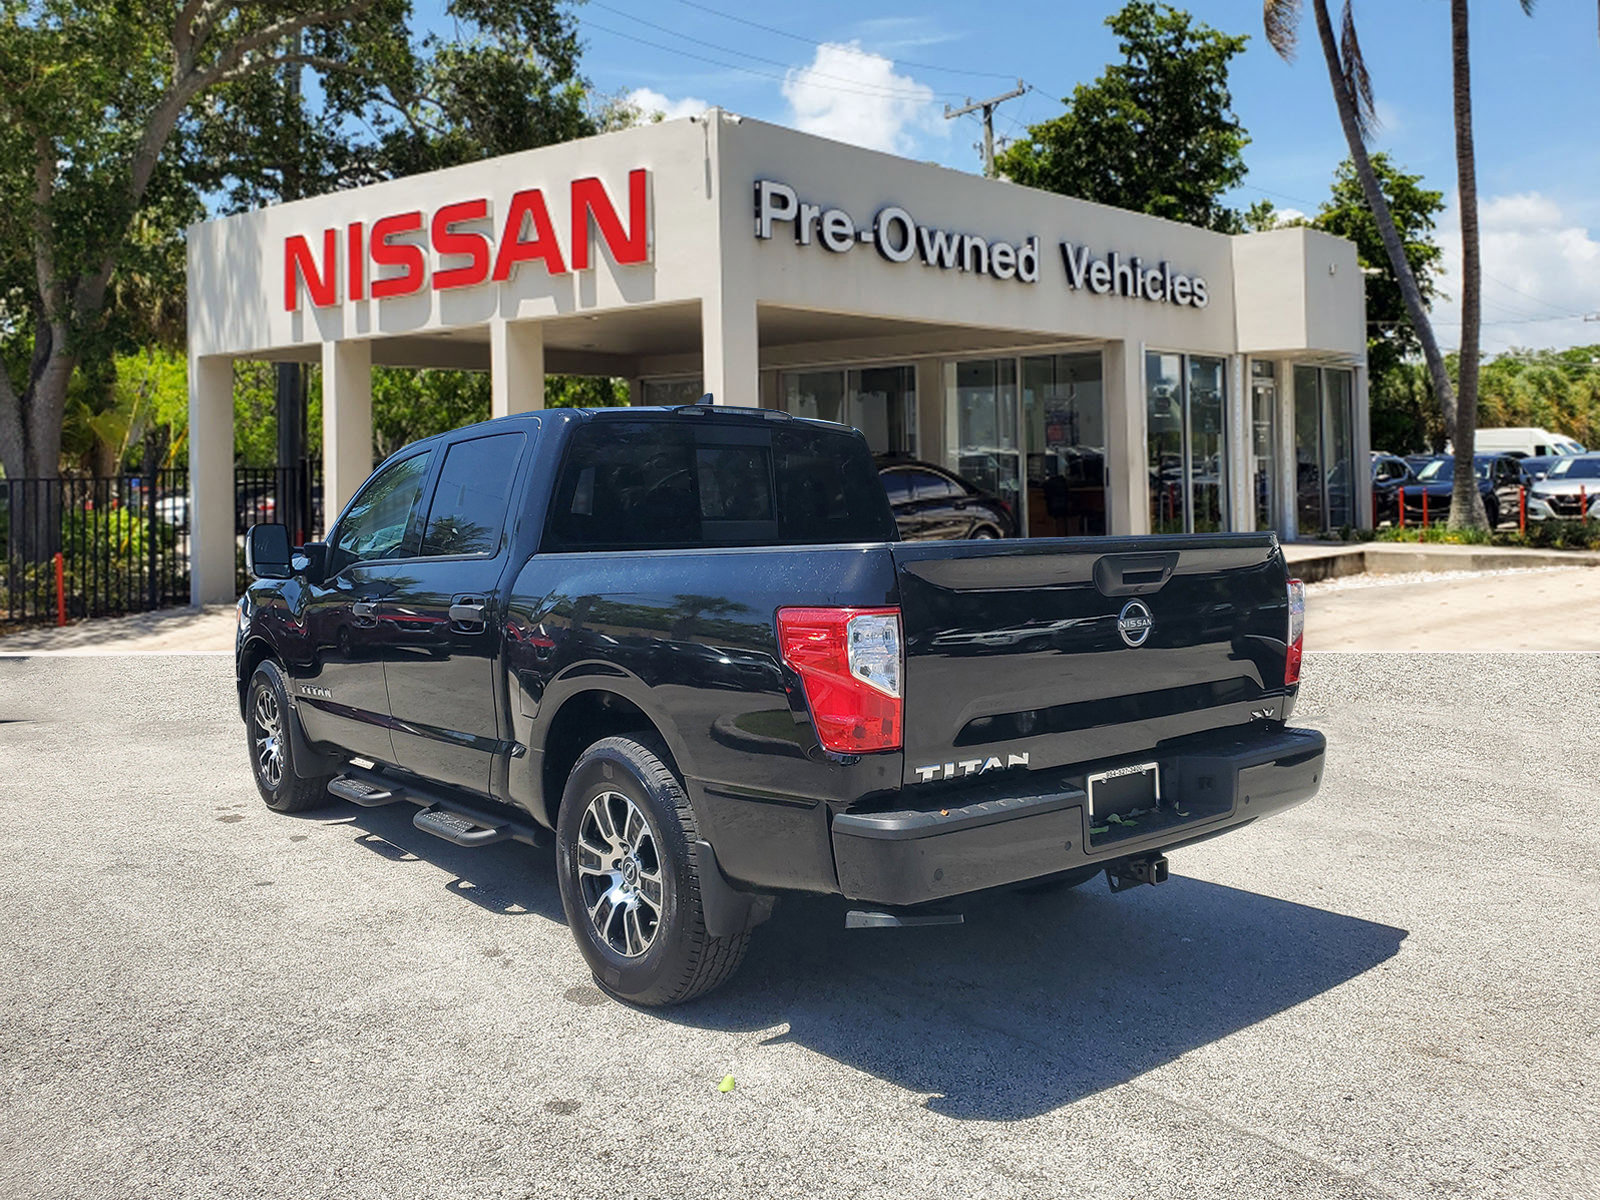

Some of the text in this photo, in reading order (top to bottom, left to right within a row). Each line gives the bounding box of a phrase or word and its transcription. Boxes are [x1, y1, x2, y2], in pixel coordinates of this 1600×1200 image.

[285, 169, 646, 312] NISSAN
[755, 180, 1208, 308] Pre-Owned Vehicles
[1120, 618, 1152, 629] NISSAN
[299, 684, 334, 698] TITAN
[915, 752, 1029, 784] TITAN
